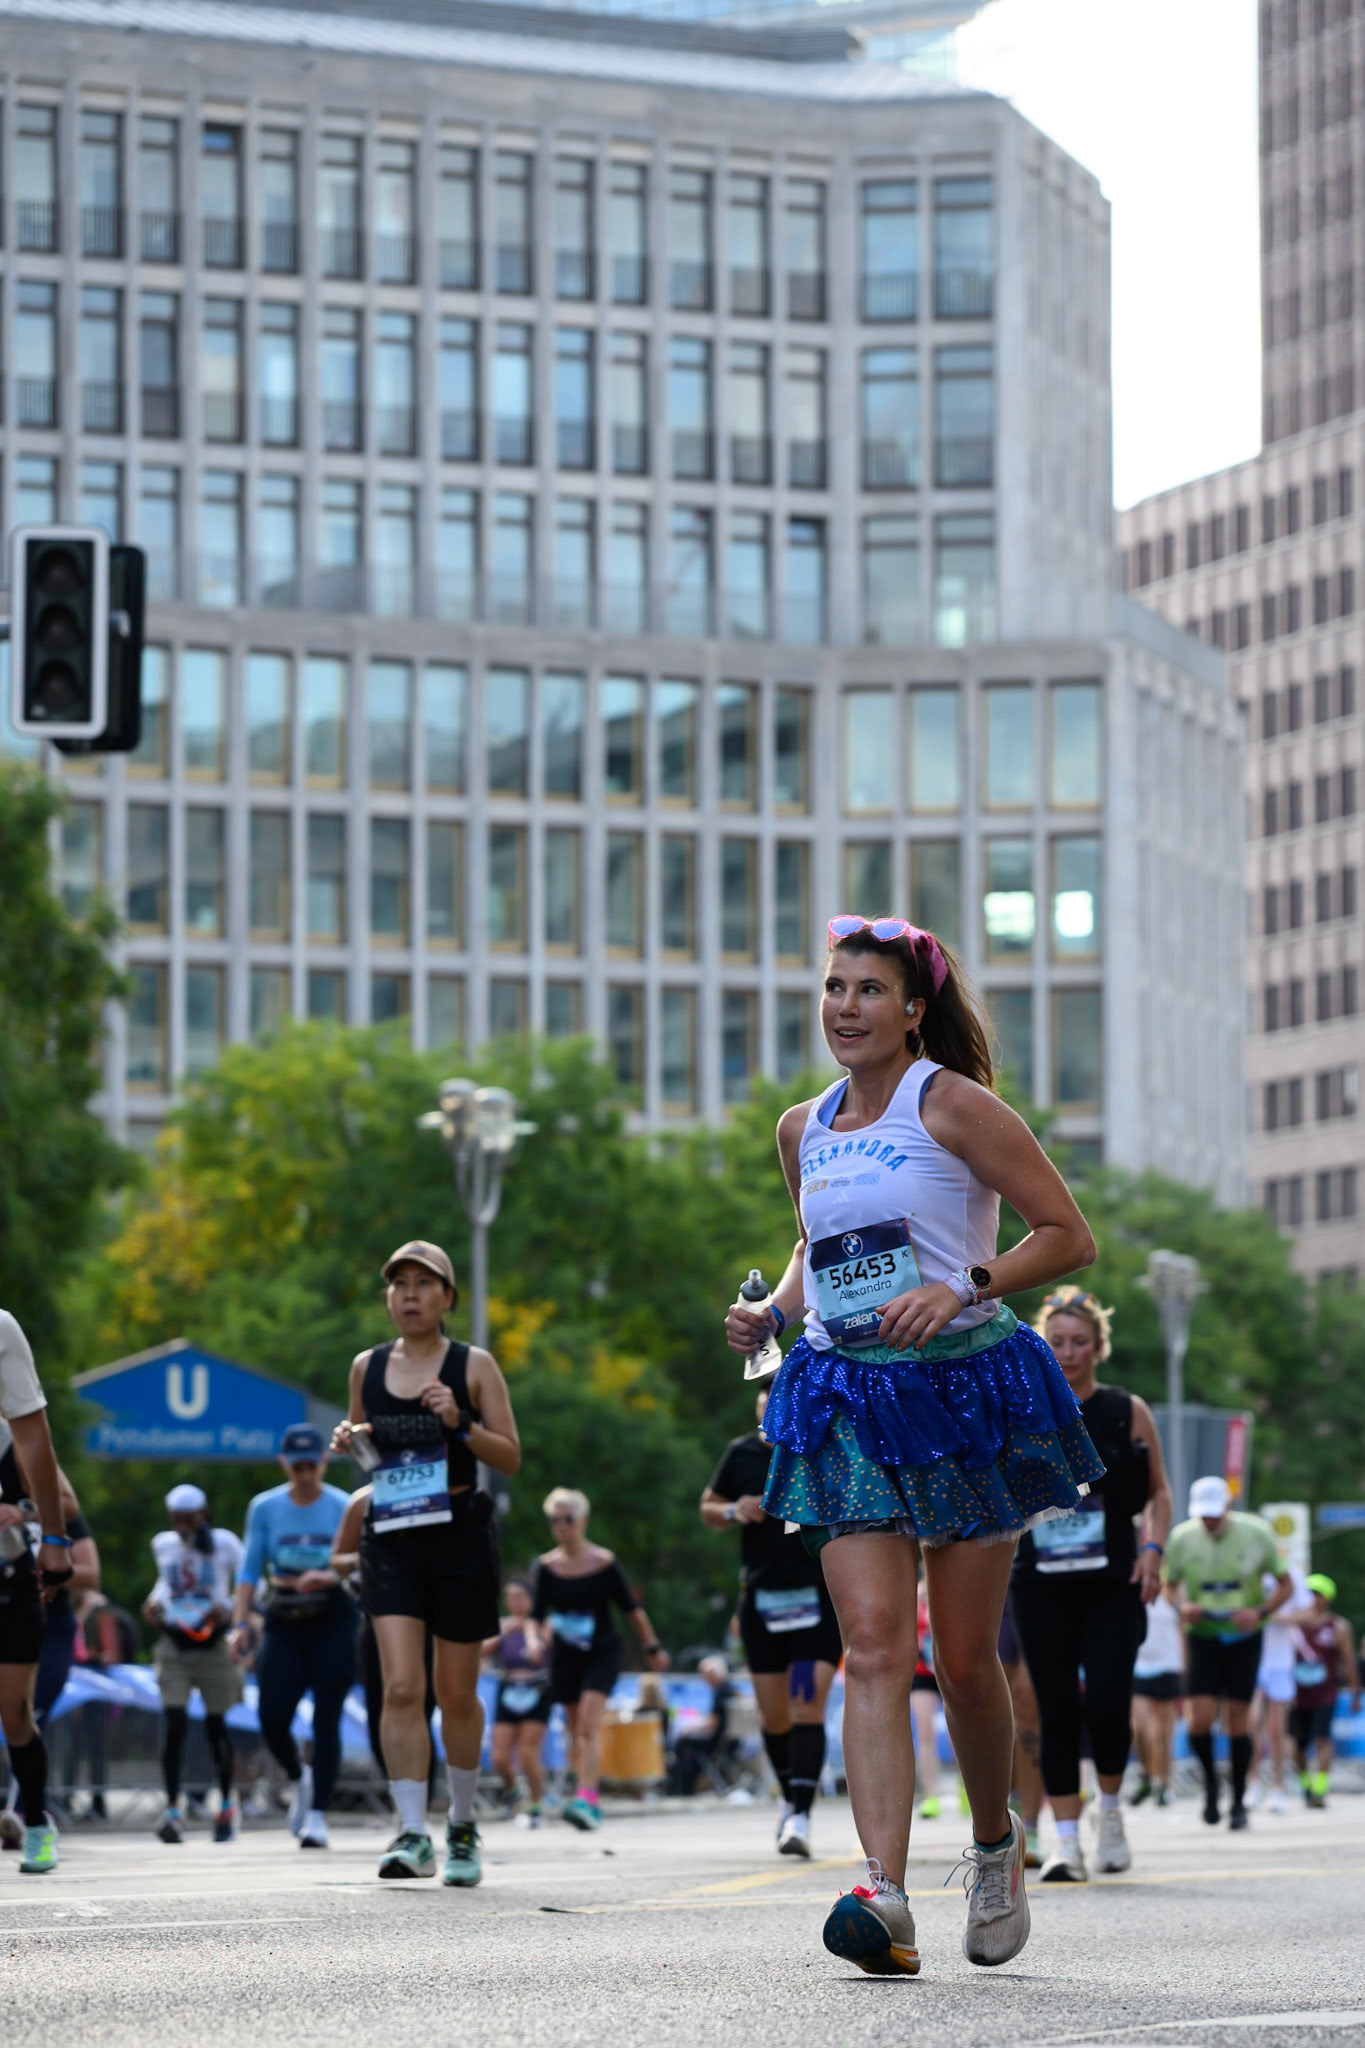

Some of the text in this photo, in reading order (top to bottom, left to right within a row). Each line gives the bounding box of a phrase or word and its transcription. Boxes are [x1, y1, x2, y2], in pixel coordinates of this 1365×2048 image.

[901, 1249, 909, 1258] K
[829, 1253, 896, 1290] 56453
[839, 1280, 892, 1302] Alexandra
[842, 1312, 883, 1330] zalan
[165, 1362, 210, 1420] U
[387, 1463, 435, 1485] 67753
